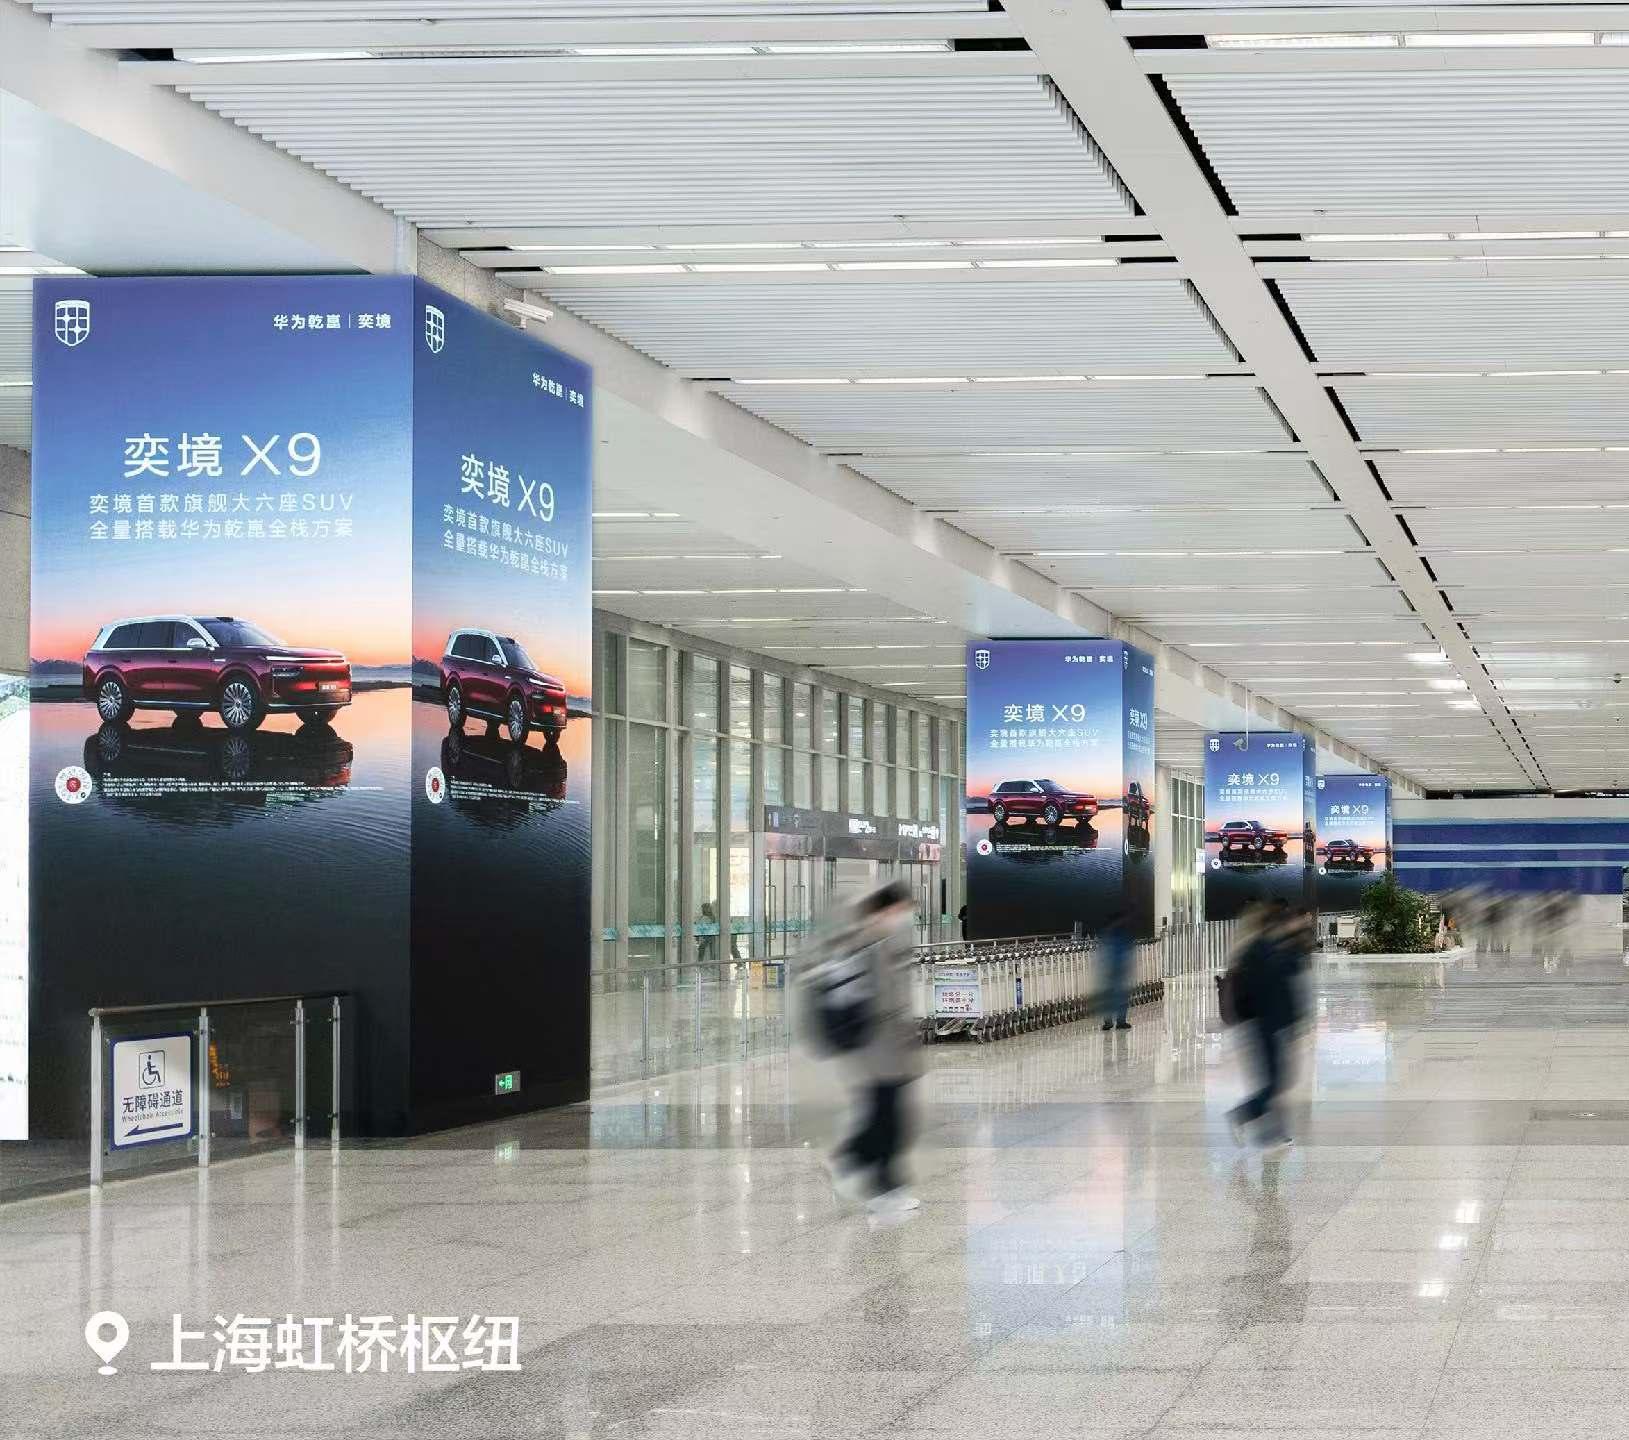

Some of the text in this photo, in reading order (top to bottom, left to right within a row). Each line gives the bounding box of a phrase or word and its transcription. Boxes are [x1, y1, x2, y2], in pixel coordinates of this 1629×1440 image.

[358, 313, 391, 329] 奕境
[124, 432, 321, 477] 奕境 X9
[461, 453, 555, 522] 奕境 X9
[90, 494, 353, 514] 奕境首款旗舰大六座SUV
[1004, 703, 1086, 723] 奕境 X9
[1258, 772, 1280, 785] X9
[122, 1089, 183, 1113] 无障碍通道
